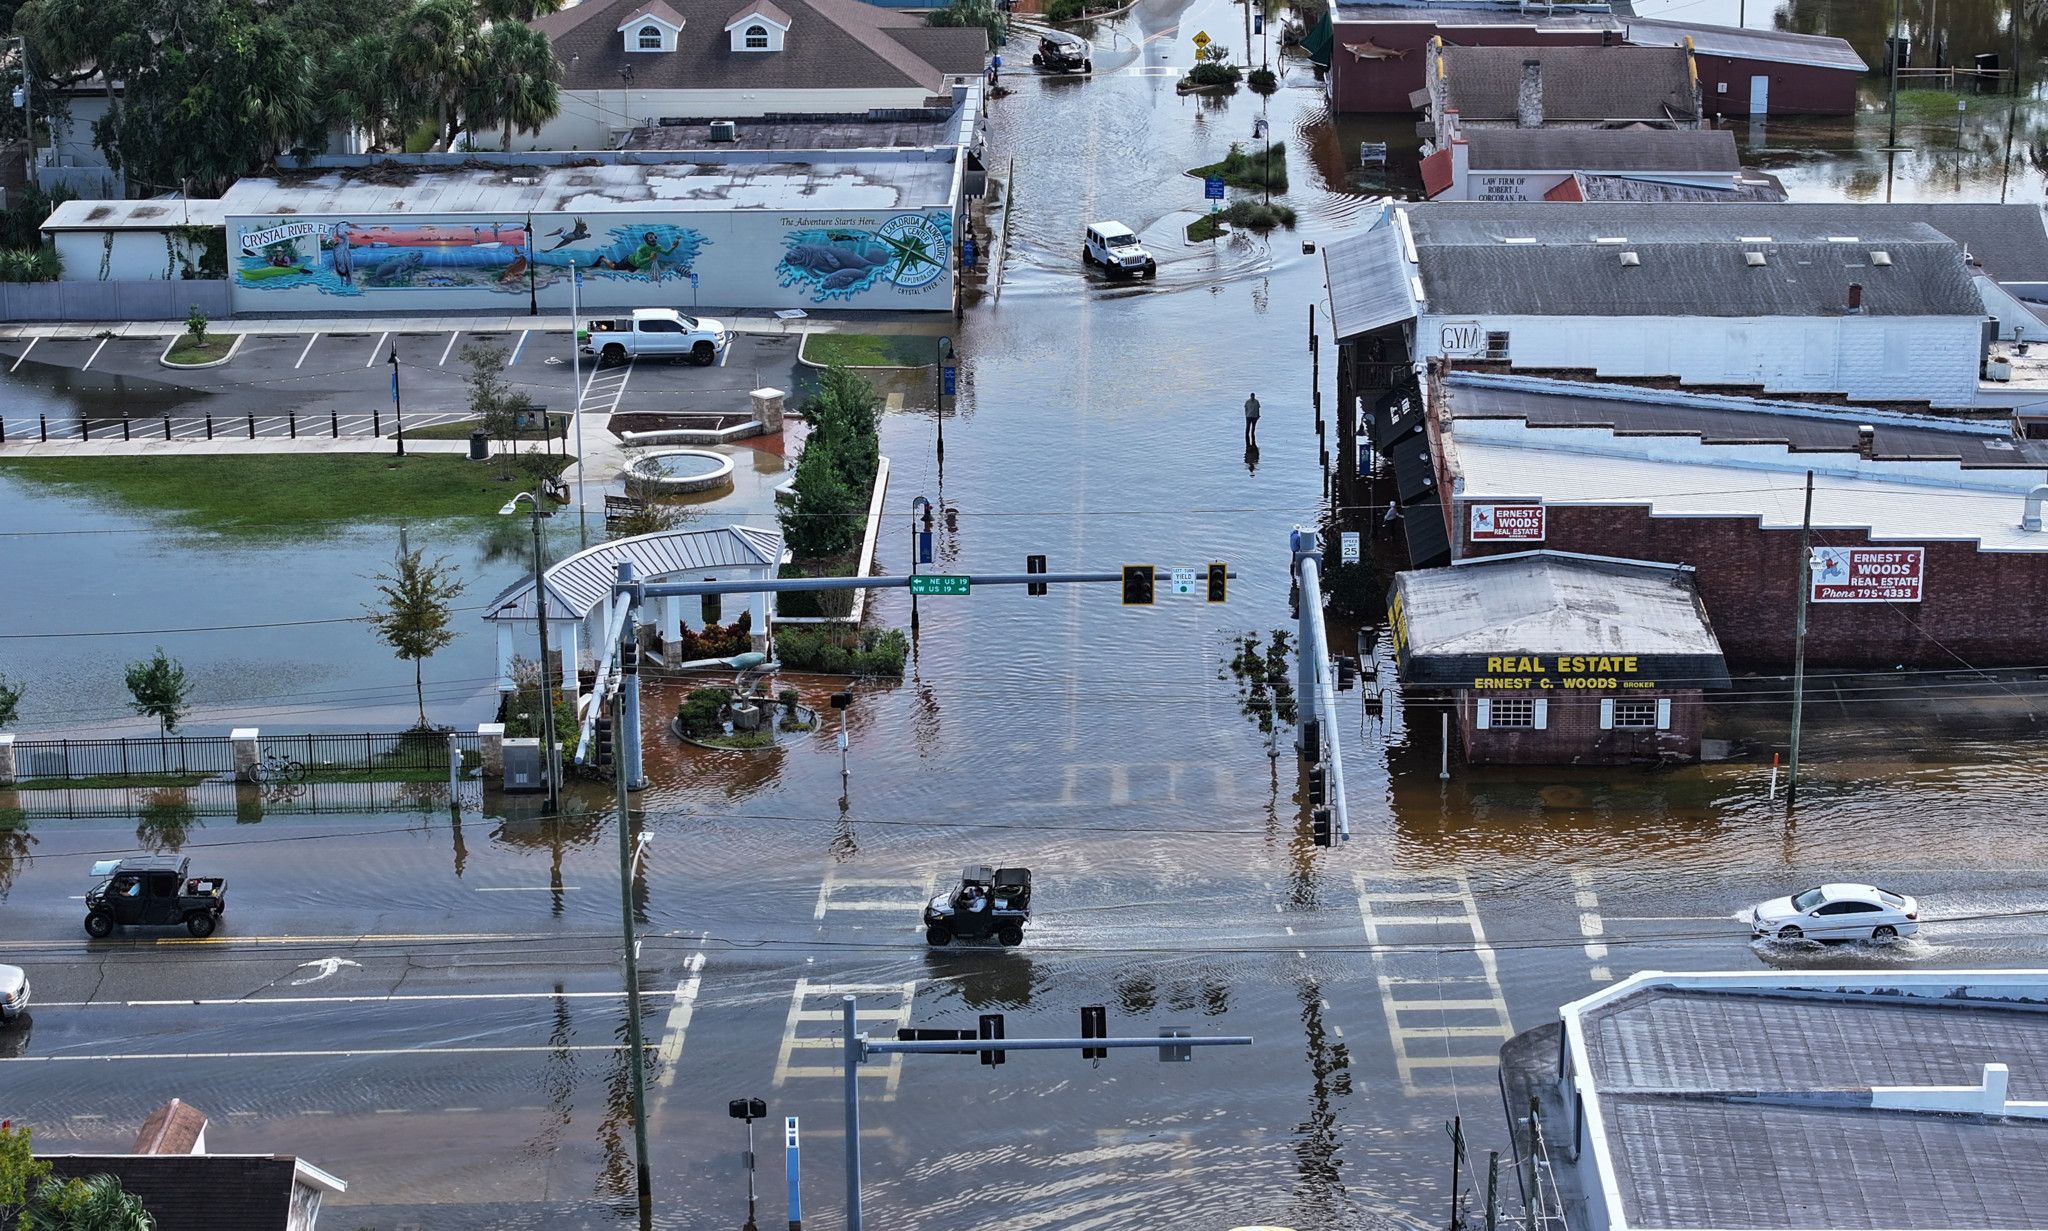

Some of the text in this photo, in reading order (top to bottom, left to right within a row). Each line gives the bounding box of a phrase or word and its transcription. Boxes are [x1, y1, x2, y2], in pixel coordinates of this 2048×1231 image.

[1482, 178, 1526, 186] LAW FIRM OF
[781, 218, 794, 226] The
[794, 217, 832, 226] Adventure
[834, 217, 856, 226] Starts
[242, 228, 286, 248] CRYSTAL
[318, 224, 328, 234] FL
[884, 216, 944, 260] EXPLORIDA ADVENTURE
[908, 228, 930, 242] CENTER
[1442, 328, 1478, 348] GYM
[1498, 518, 1539, 528] WOODS
[1854, 554, 1915, 563] ERNEST C
[1857, 564, 1911, 575] WOODS
[1851, 577, 1919, 586] REAL ESTATE
[1822, 588, 1856, 598] Phone
[1487, 656, 1638, 672] REAL ESTATE
[1474, 678, 1532, 689] ERNEST
[1540, 678, 1554, 689] C.
[1564, 678, 1618, 689] WOODS
